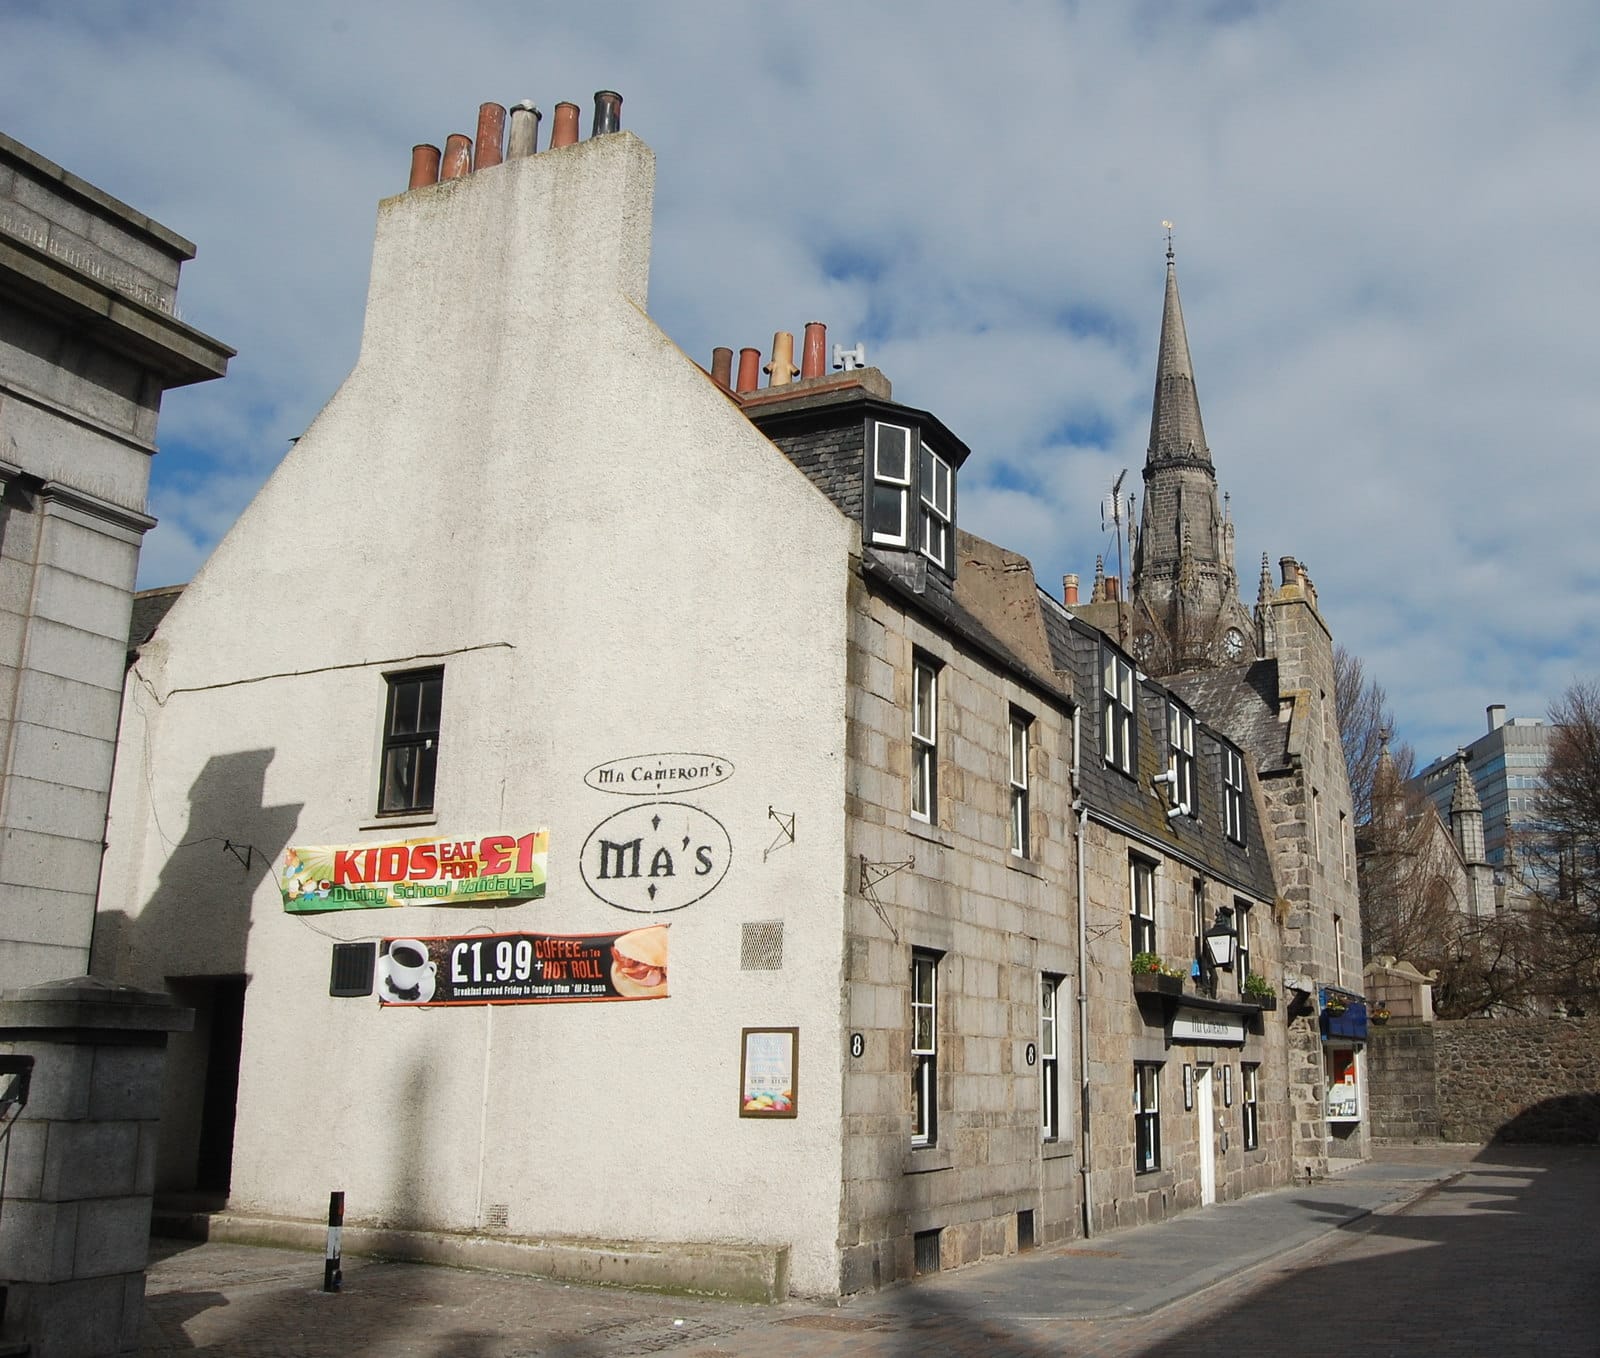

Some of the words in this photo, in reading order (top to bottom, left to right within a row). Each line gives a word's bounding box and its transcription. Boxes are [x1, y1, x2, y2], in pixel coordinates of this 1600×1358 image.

[439, 841, 476, 861] EAT
[334, 844, 438, 885] KIDS
[439, 861, 478, 880] FOR
[333, 885, 389, 903] During
[393, 881, 451, 899] School
[456, 876, 535, 894] Holidays
[535, 940, 583, 959] COFFEE
[451, 940, 532, 983] £1.99
[543, 960, 568, 980] HOT
[571, 959, 603, 979] ROLL
[453, 986, 482, 997] Breakfast
[483, 986, 503, 996] served
[504, 985, 523, 996] Friday
[523, 985, 531, 995] to
[531, 984, 553, 995] Sunday
[554, 984, 570, 993] 10am
[583, 983, 590, 993] 12
[853, 1034, 862, 1056] 8
[1027, 1045, 1035, 1064] 8
